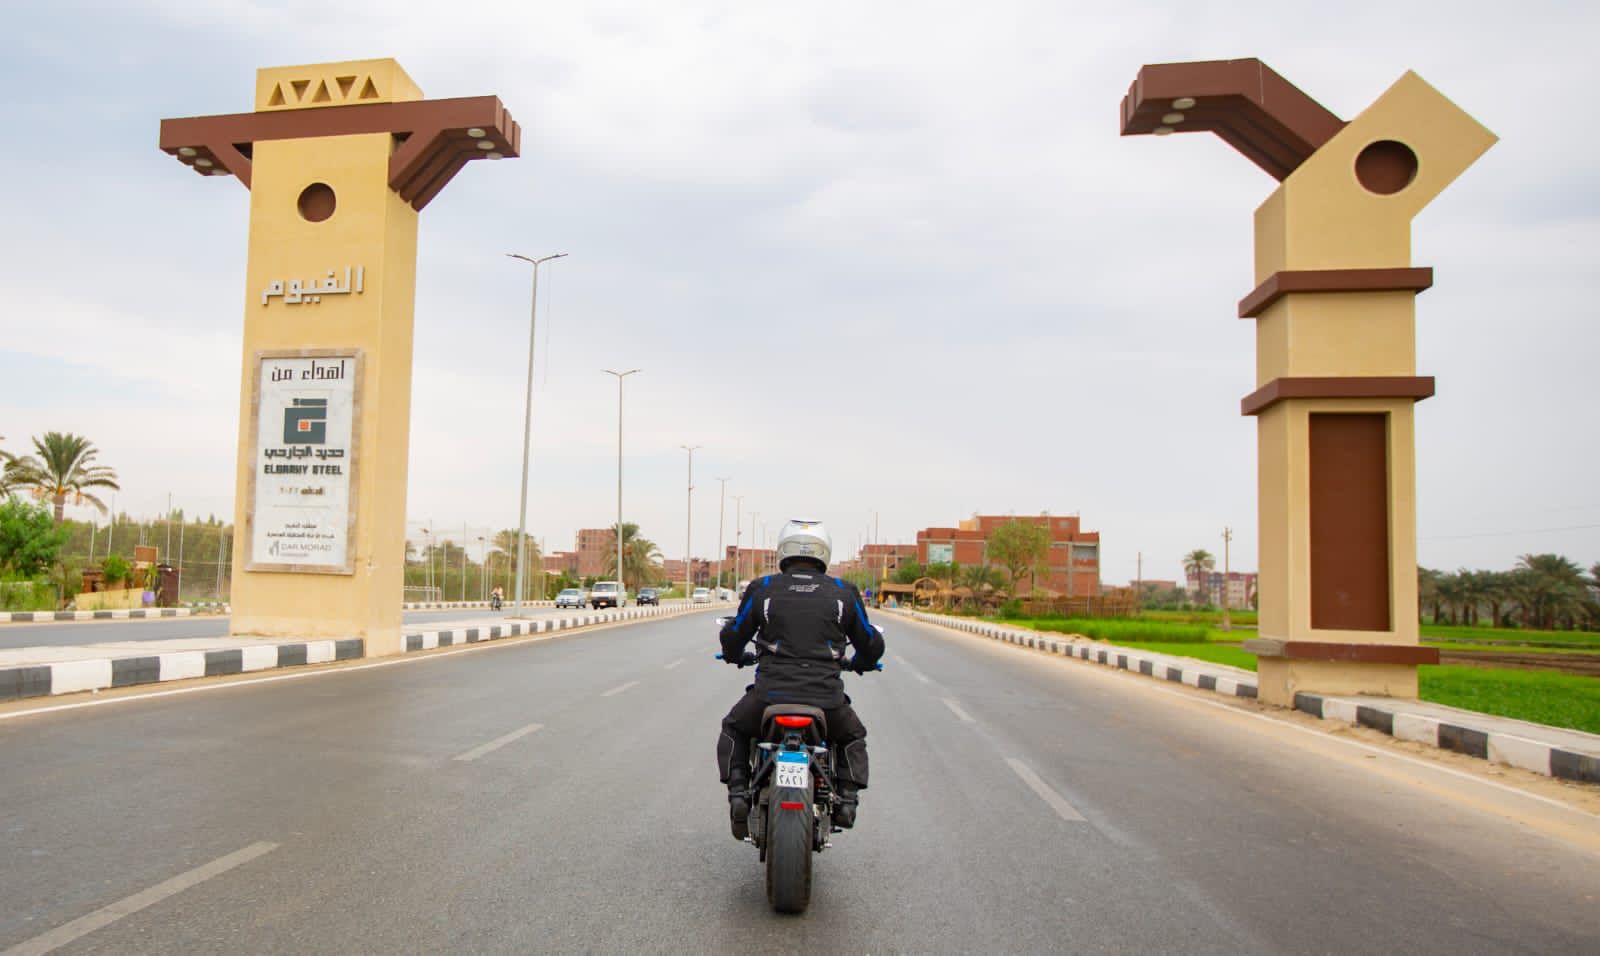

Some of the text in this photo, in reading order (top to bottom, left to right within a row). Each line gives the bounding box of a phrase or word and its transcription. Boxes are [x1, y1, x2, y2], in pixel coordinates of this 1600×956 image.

[261, 264, 364, 306] الفيوم
[271, 365, 292, 382] من
[314, 448, 344, 461] حديد
[312, 464, 343, 475] STEEL
